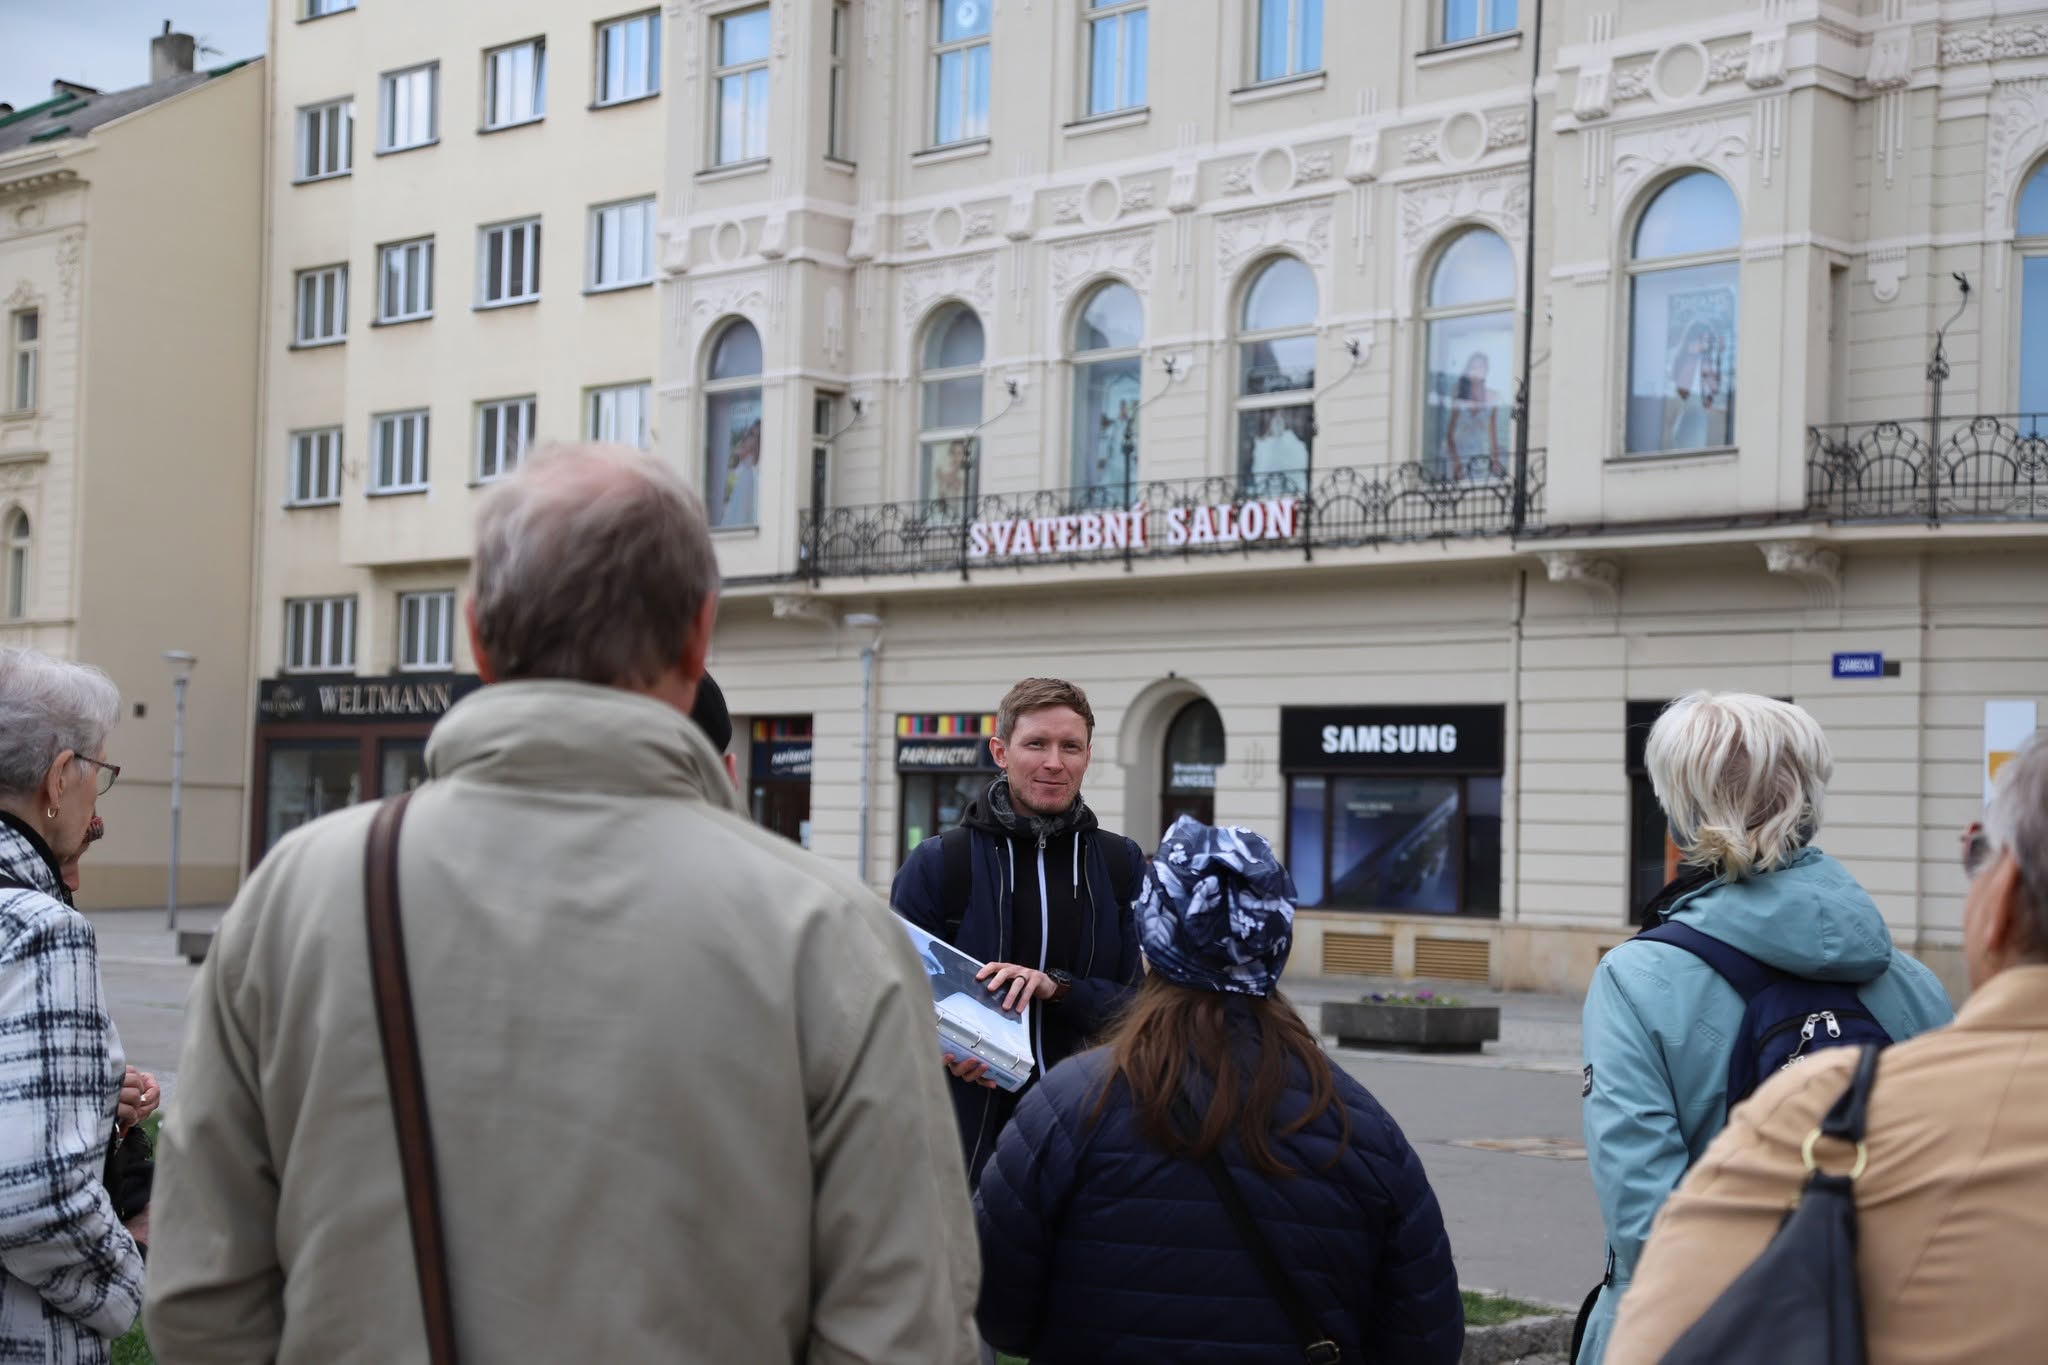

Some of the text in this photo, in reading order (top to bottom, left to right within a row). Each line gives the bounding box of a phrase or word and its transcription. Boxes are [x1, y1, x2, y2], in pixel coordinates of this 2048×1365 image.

[969, 498, 1298, 557] SVATEBNÍ SALON
[319, 684, 451, 715] WELTMANN
[1321, 723, 1458, 754] SAMSUNG
